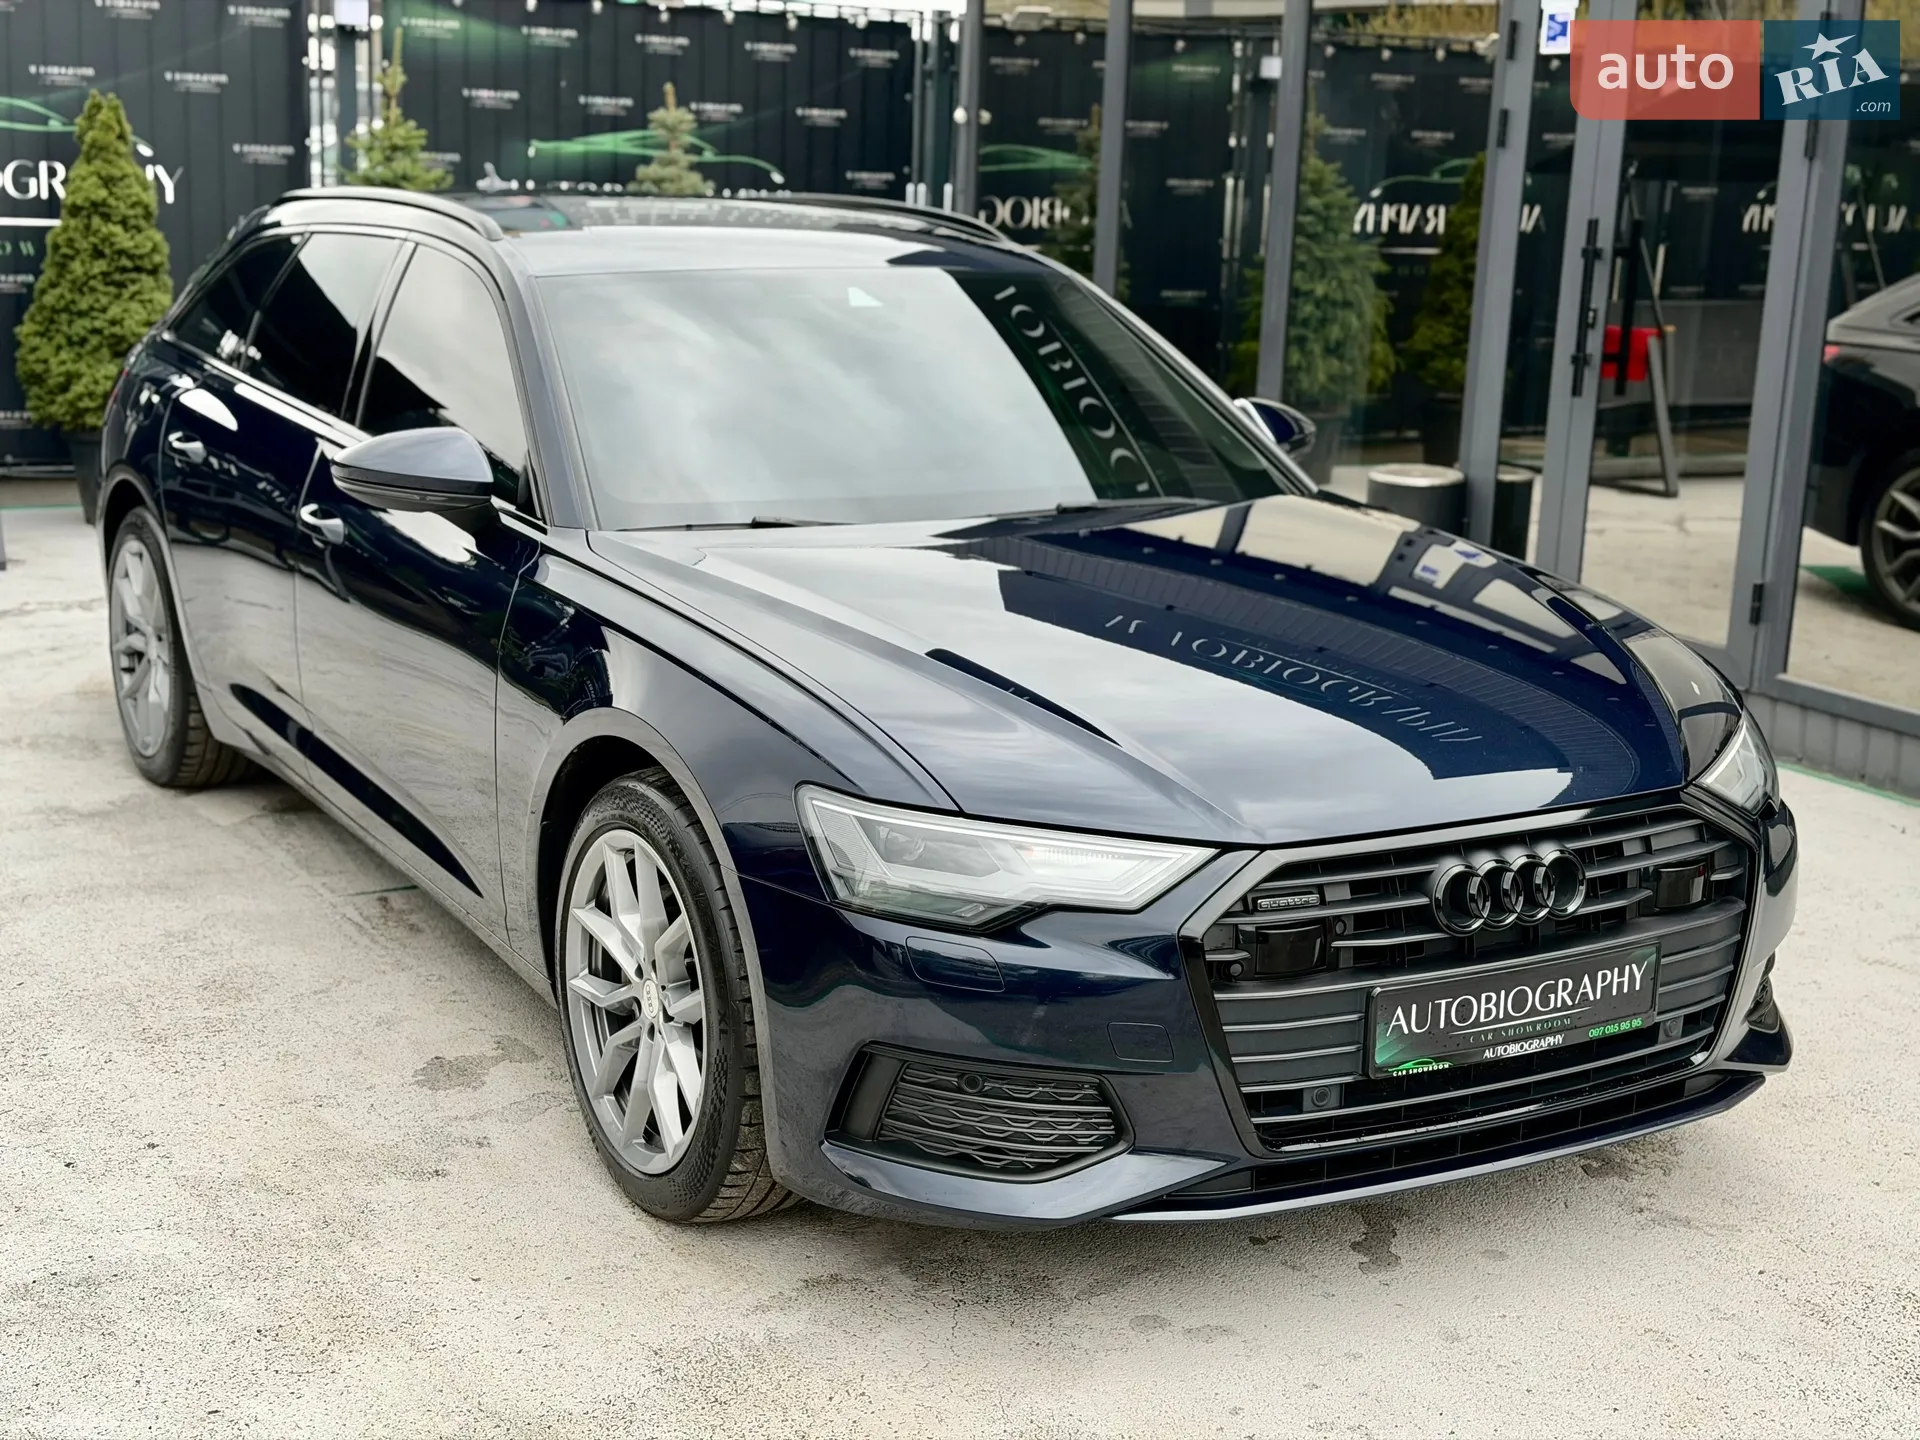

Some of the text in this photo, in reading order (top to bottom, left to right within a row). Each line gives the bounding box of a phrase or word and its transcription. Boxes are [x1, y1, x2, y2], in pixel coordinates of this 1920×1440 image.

[1261, 897, 1318, 909] quattro
[1386, 960, 1649, 1037] AUTOBIOGRAPHY
[1470, 1018, 1573, 1044] CAR SHOWROOM
[1588, 1026, 1604, 1038] 097
[1604, 1023, 1619, 1034] 015
[1483, 1033, 1565, 1060] AUTOBIOGRAPHY
